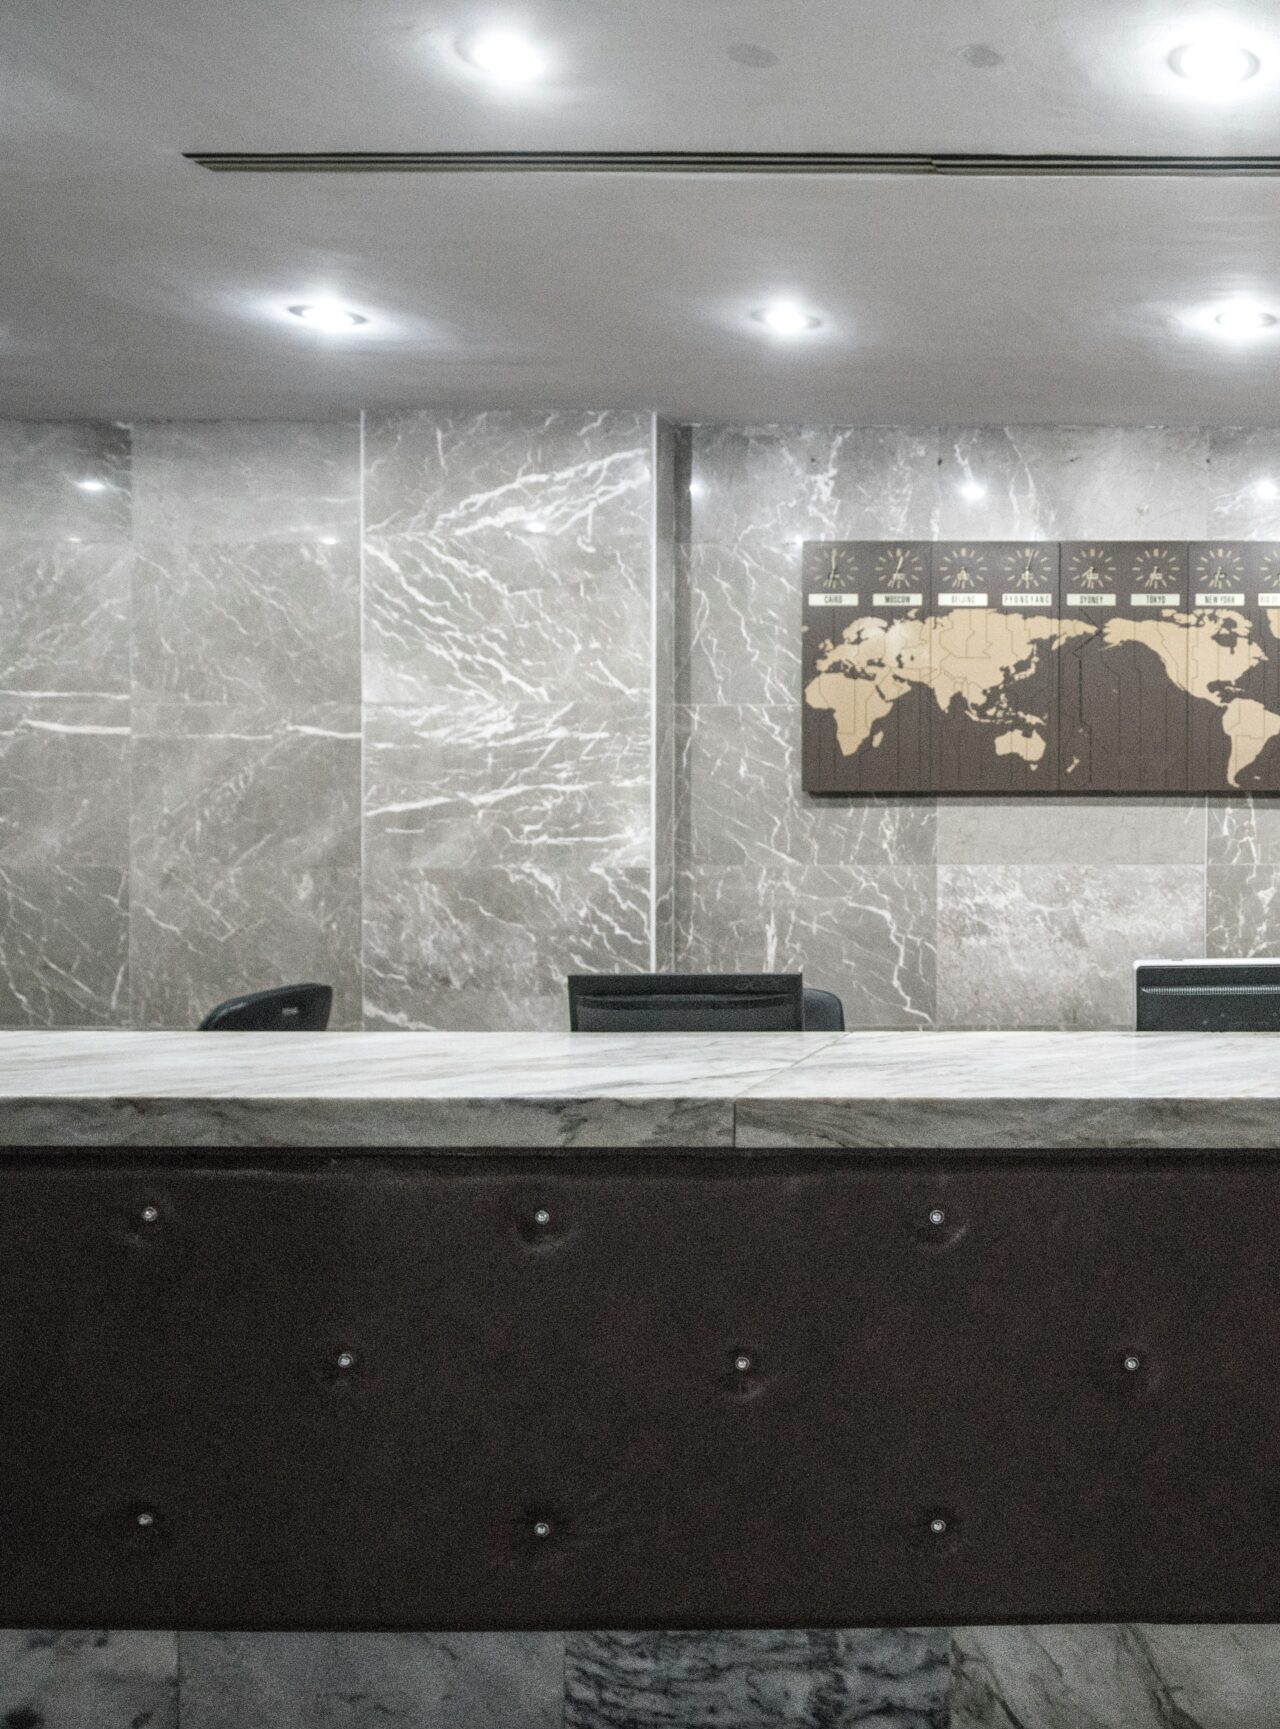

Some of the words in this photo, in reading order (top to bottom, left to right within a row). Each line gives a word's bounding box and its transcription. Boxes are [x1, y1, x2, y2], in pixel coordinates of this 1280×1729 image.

[824, 595, 843, 604] CAIRO
[884, 595, 911, 604] MOSCOW
[951, 595, 976, 603] BEIJING
[1004, 595, 1050, 604] PYONGYANG
[1079, 595, 1104, 604] SYDNEY
[1146, 595, 1166, 604] TOKYO
[1204, 595, 1218, 603] NEW
[1220, 595, 1236, 604] YORK
